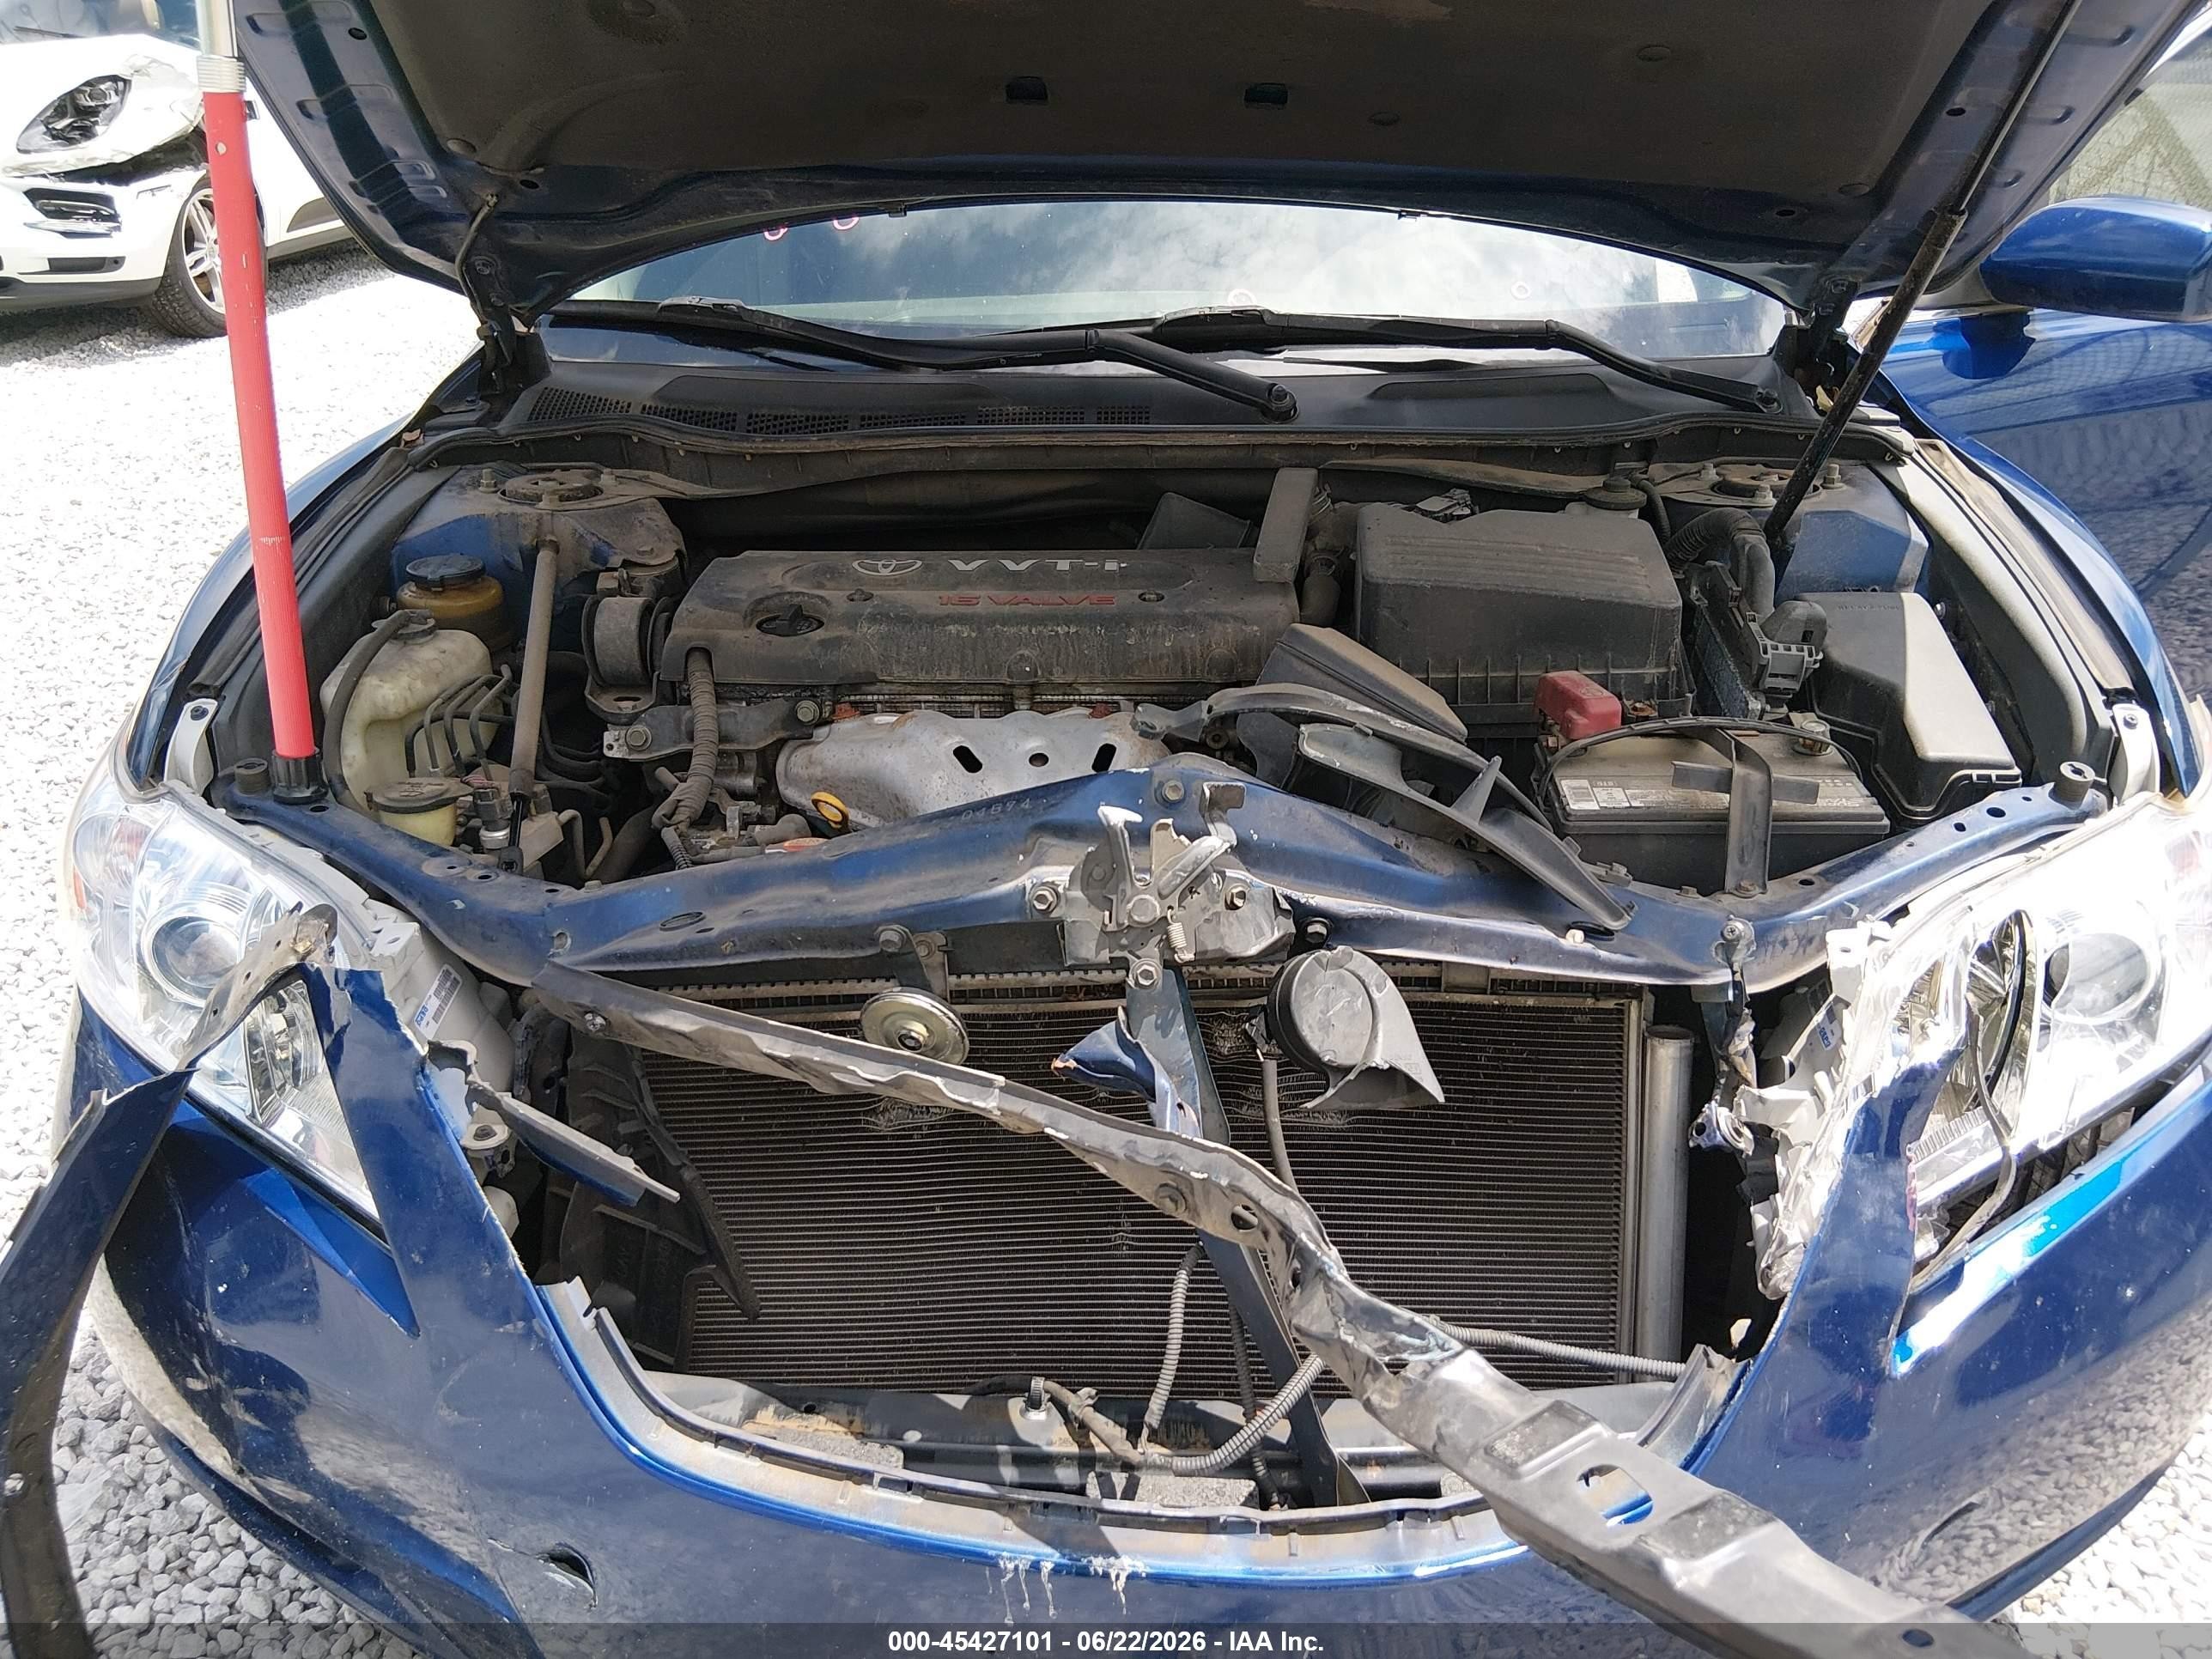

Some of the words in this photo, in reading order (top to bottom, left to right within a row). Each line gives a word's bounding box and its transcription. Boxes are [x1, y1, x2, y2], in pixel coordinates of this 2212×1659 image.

[948, 559, 1127, 571] VVT-i
[939, 594, 981, 606] 16
[988, 594, 1115, 606] VALVE
[415, 1004, 428, 1027] DEPO
